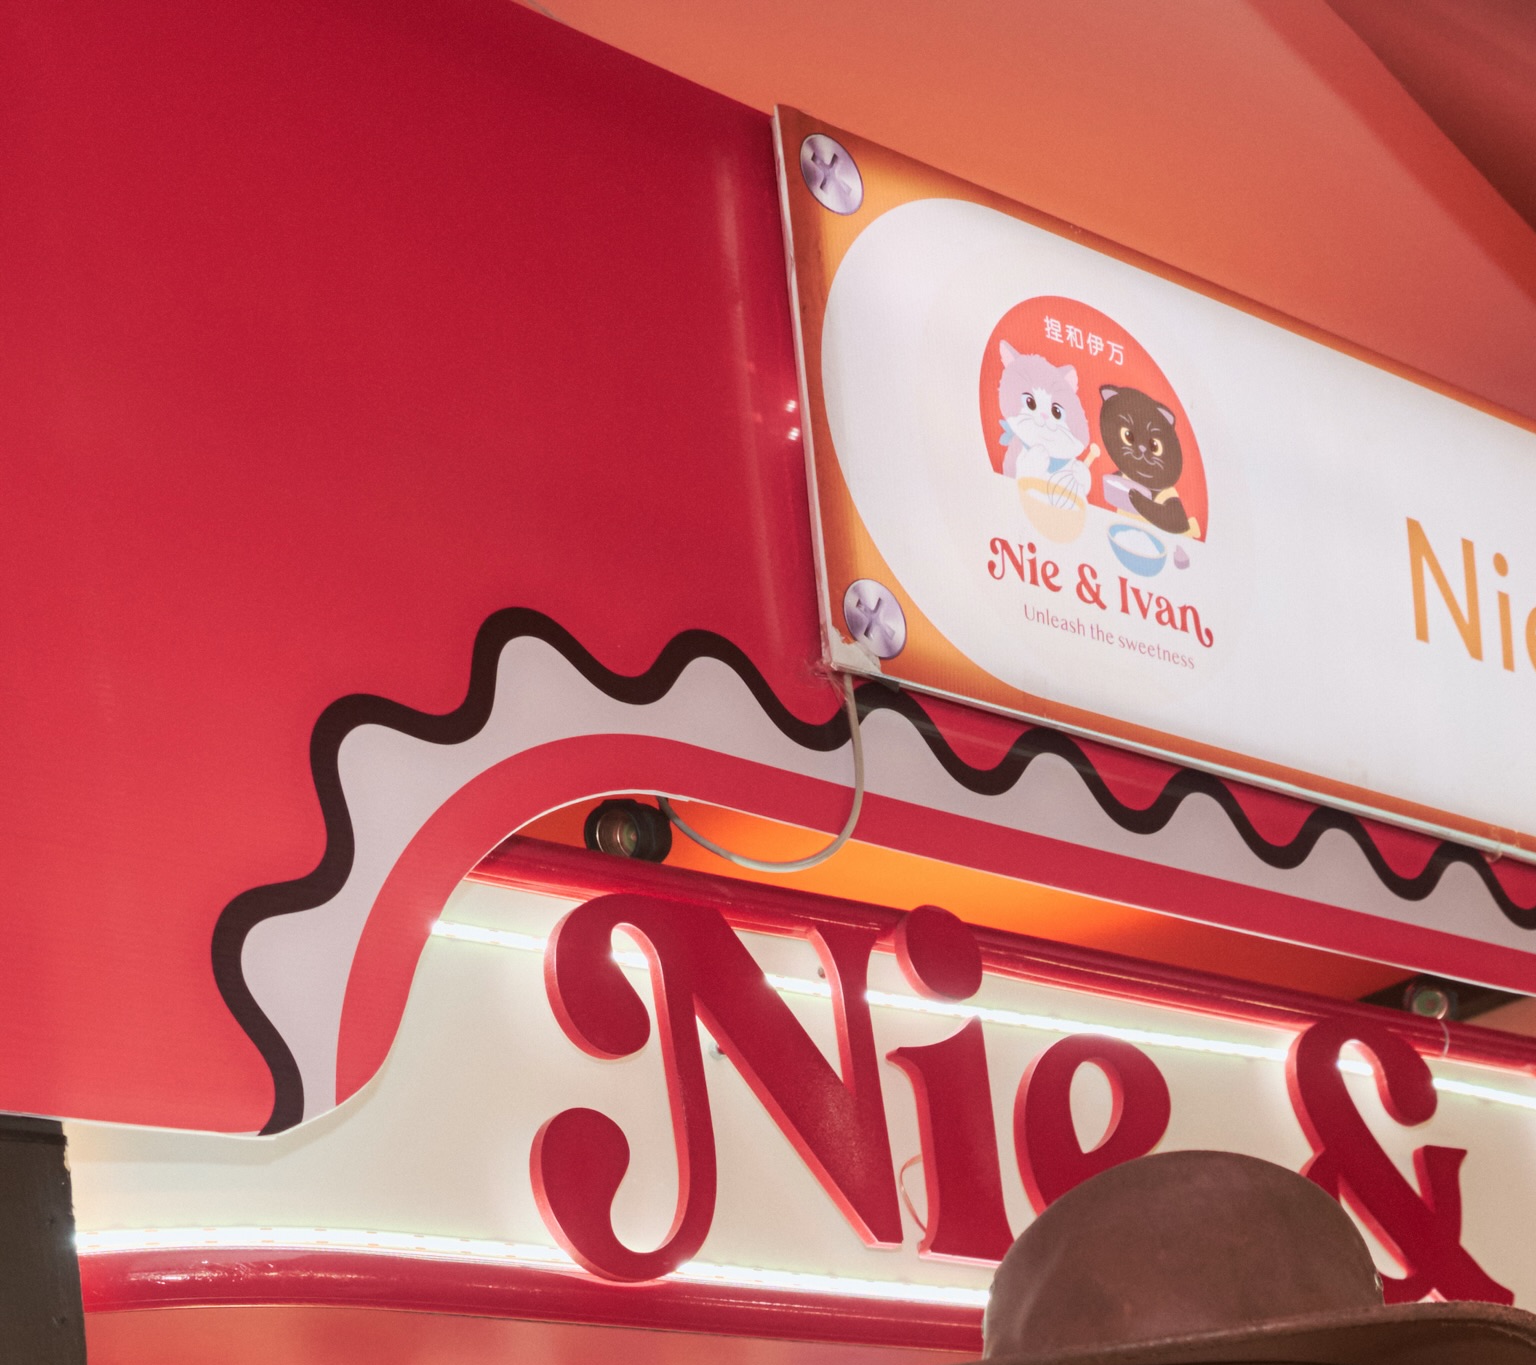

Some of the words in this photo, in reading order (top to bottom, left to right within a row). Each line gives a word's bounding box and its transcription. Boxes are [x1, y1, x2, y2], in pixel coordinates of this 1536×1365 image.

[1043, 315, 1124, 367] 捏和伊万
[987, 536, 1063, 593] Nie
[1075, 563, 1107, 612] &
[1117, 575, 1214, 648] Ivan
[1023, 603, 1086, 638] Unleash
[1090, 623, 1115, 646] the
[1118, 633, 1195, 671] sweetness
[529, 891, 1172, 1283] Nie
[1285, 1020, 1515, 1306] &
